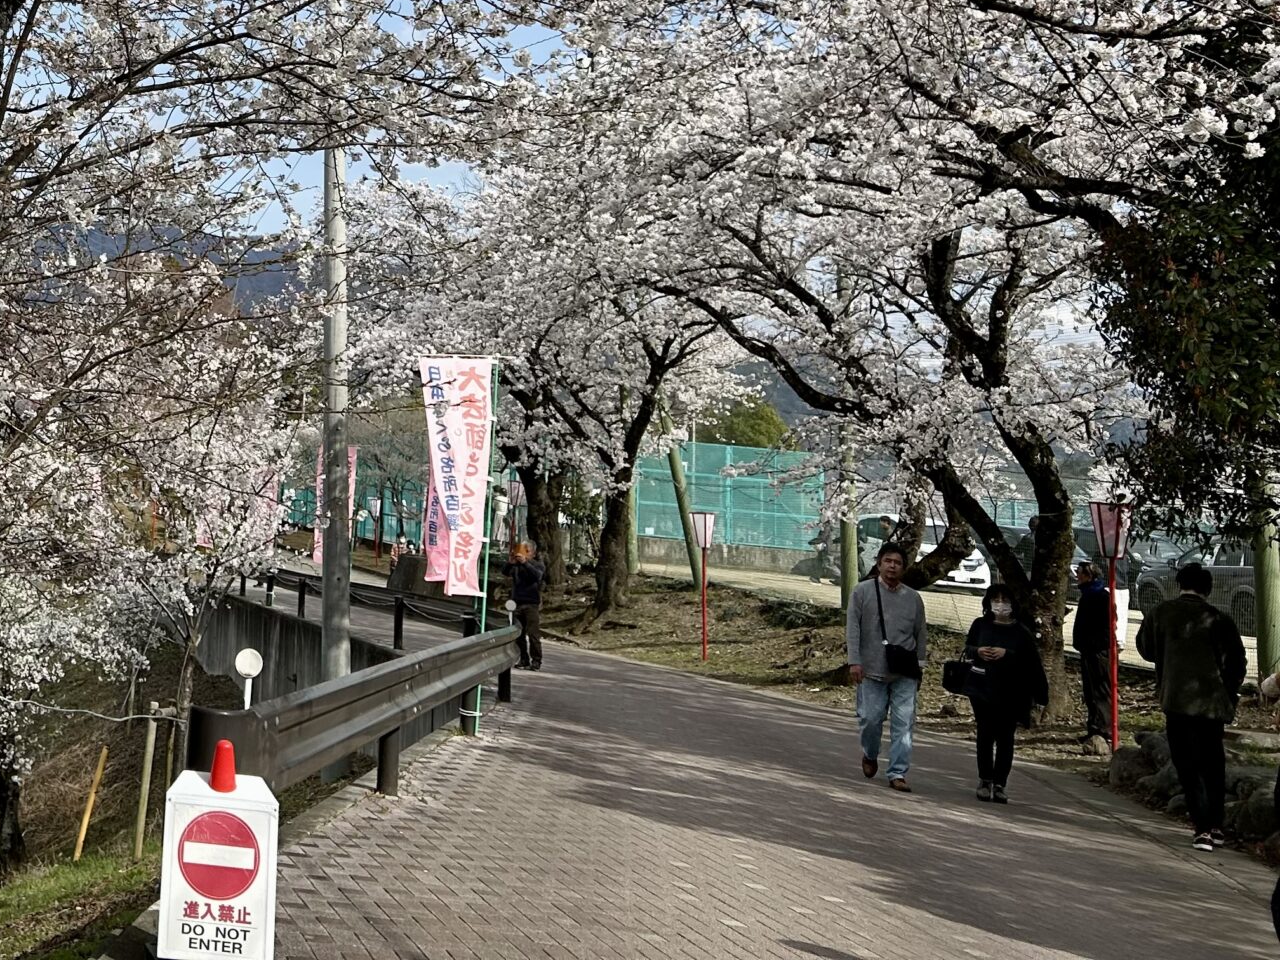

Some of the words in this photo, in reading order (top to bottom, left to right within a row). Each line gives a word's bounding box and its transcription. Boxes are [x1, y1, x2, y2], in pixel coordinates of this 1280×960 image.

[183, 900, 252, 925] 進入禁止
[181, 923, 205, 936] DO
[215, 926, 251, 941] NOT
[188, 937, 243, 954] ENTER
